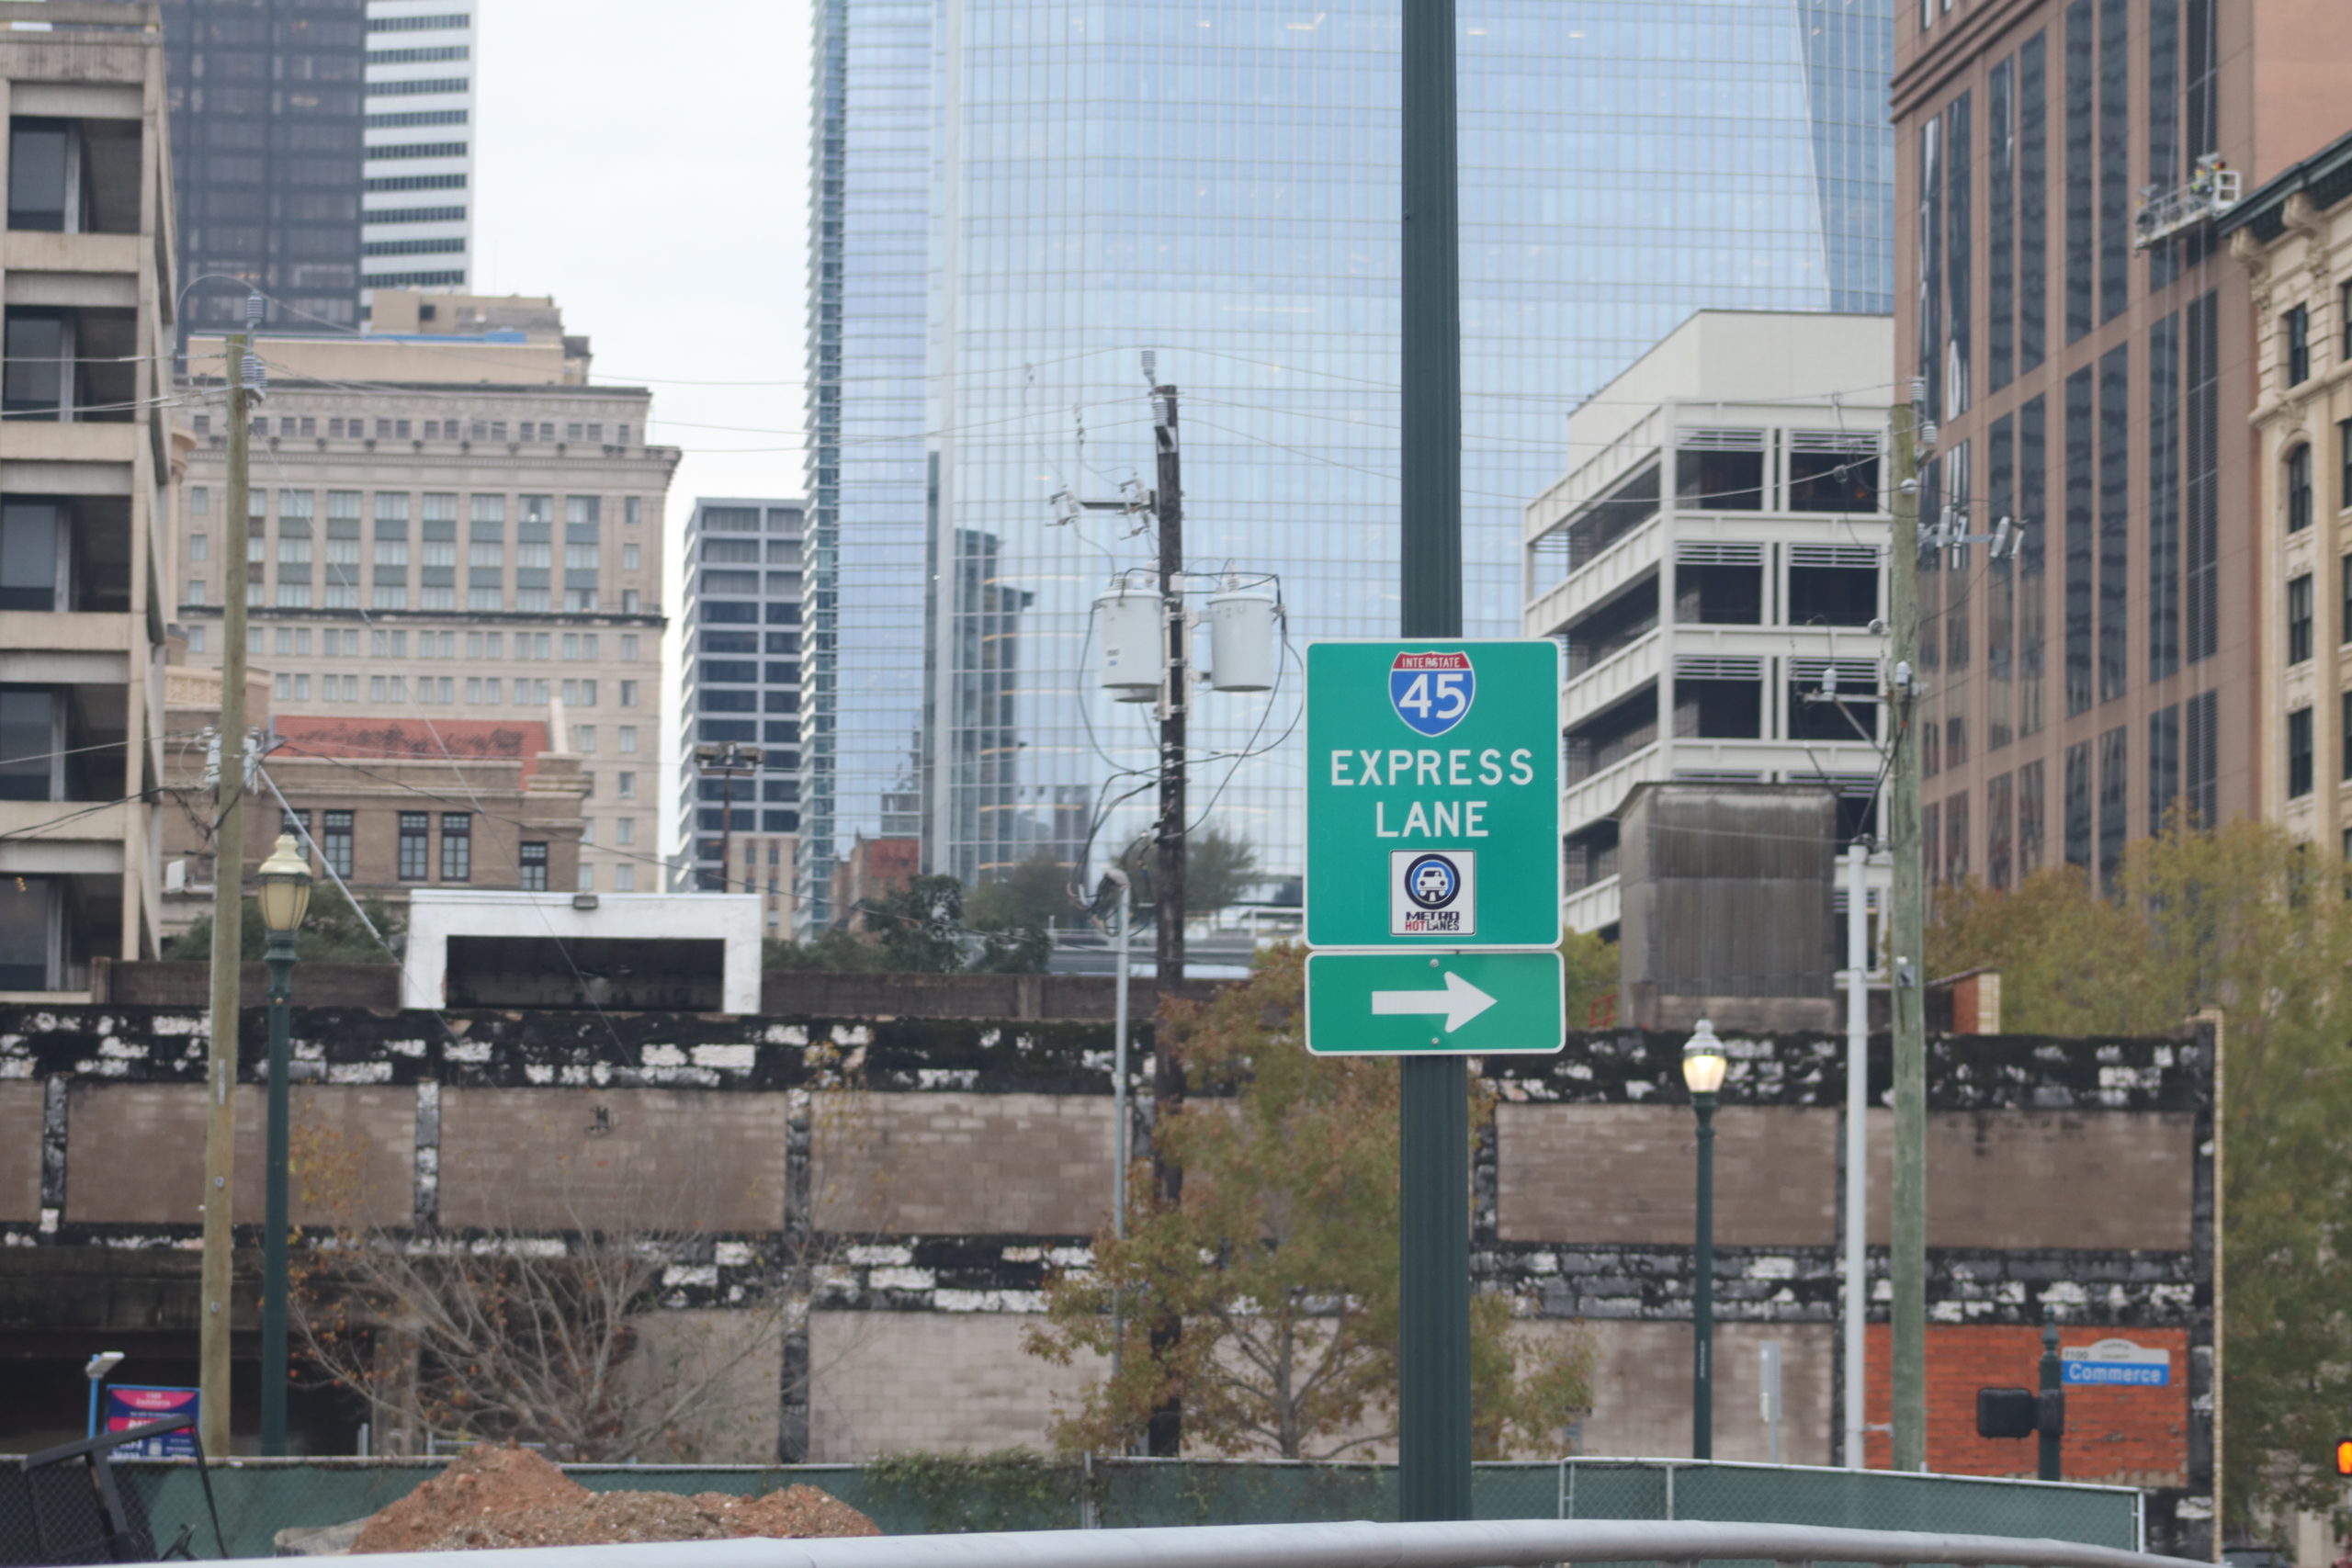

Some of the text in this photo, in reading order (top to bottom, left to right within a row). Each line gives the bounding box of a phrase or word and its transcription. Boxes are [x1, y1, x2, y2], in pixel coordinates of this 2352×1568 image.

[1402, 657, 1461, 669] INTERSTATE
[1398, 673, 1466, 719] 45
[1331, 749, 1533, 786] EXPRESS
[1376, 801, 1488, 838] LANE
[1405, 911, 1460, 921] METRO
[2069, 1363, 2162, 1382] Commerce
